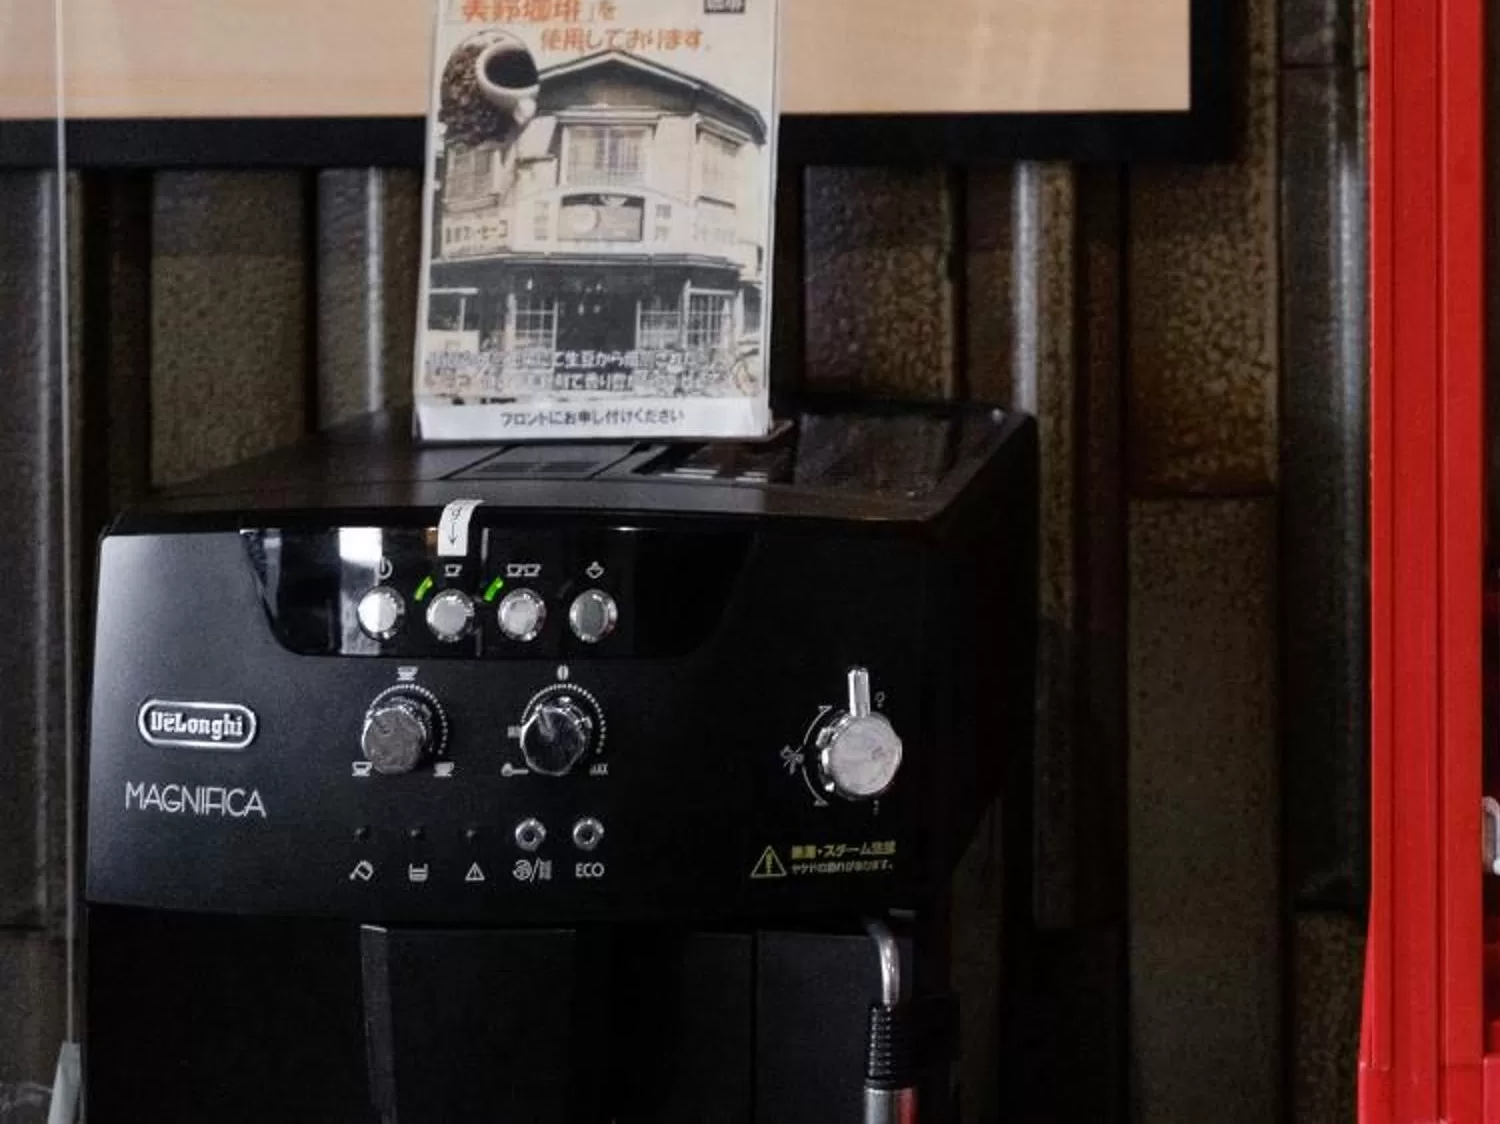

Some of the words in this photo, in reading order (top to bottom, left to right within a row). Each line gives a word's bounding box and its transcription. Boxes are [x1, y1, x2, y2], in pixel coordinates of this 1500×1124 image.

[501, 409, 685, 427] フロントにお申し付けください
[125, 780, 268, 819] MAGNIFICA
[575, 862, 606, 879] ECO
